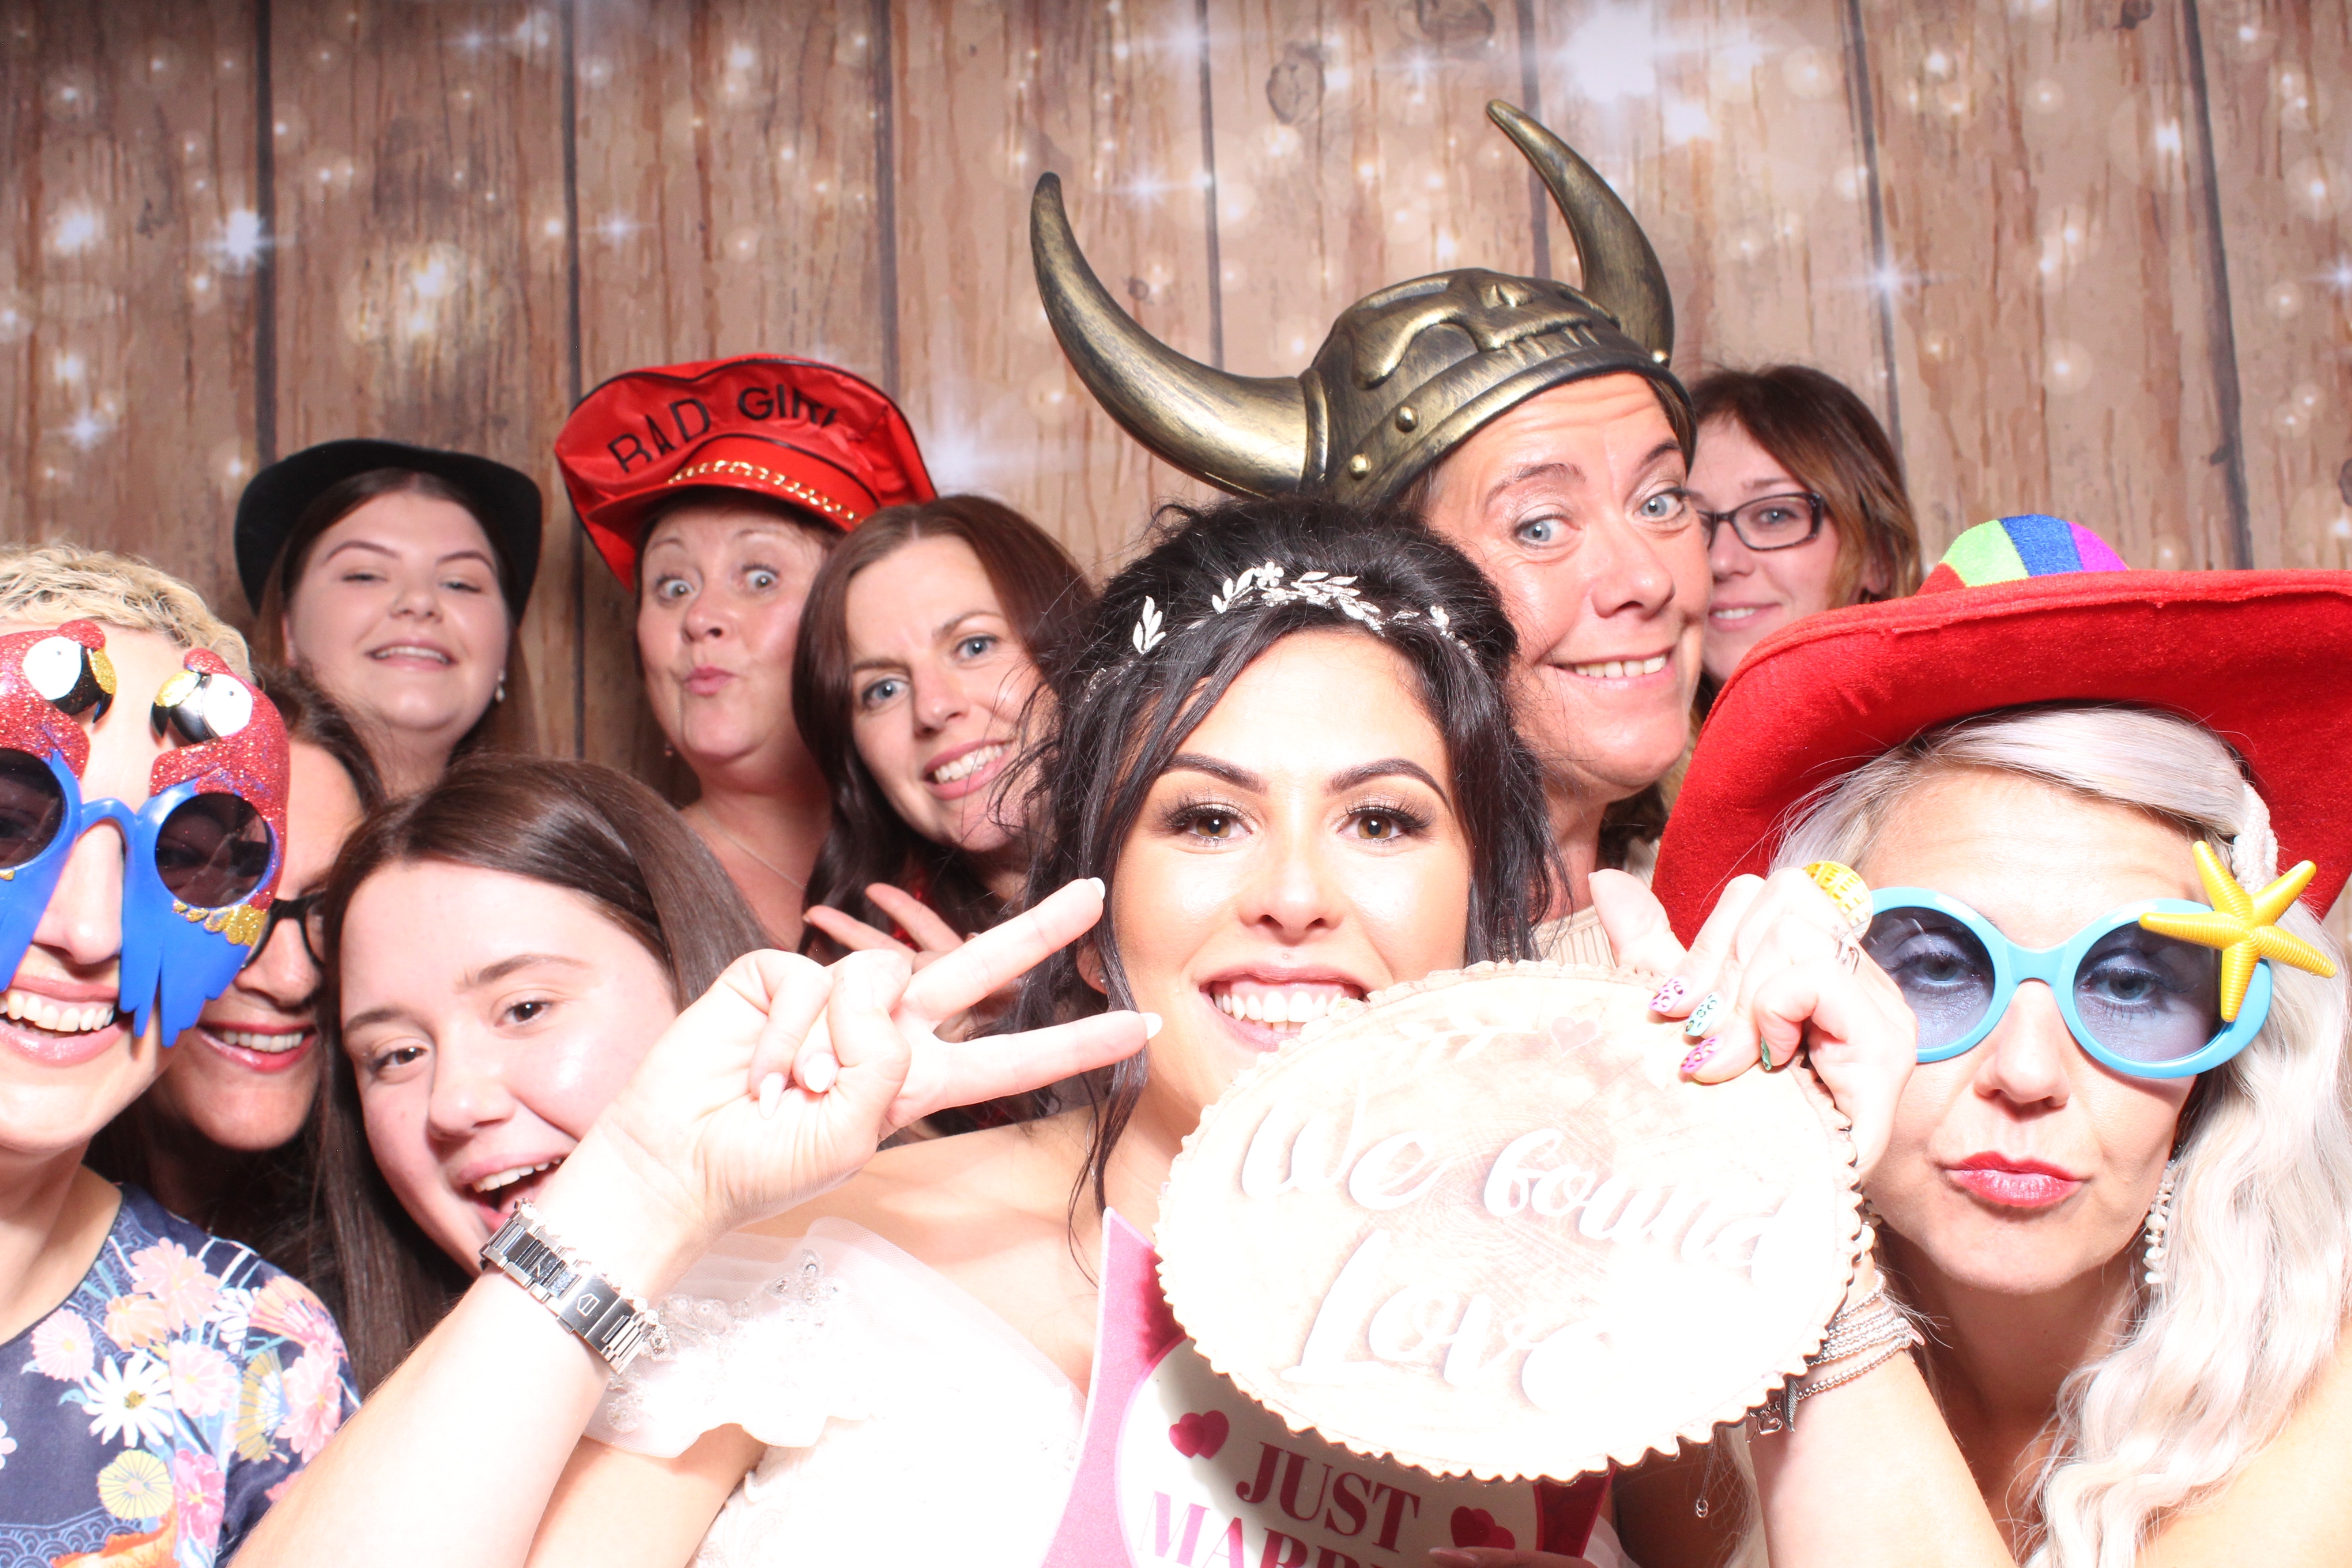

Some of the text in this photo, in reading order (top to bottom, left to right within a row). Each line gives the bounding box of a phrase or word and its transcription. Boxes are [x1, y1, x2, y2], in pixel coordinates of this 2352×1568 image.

[1241, 1074, 1455, 1210] We
[1281, 1228, 1633, 1417] Love
[1235, 1441, 1421, 1553] JUST
